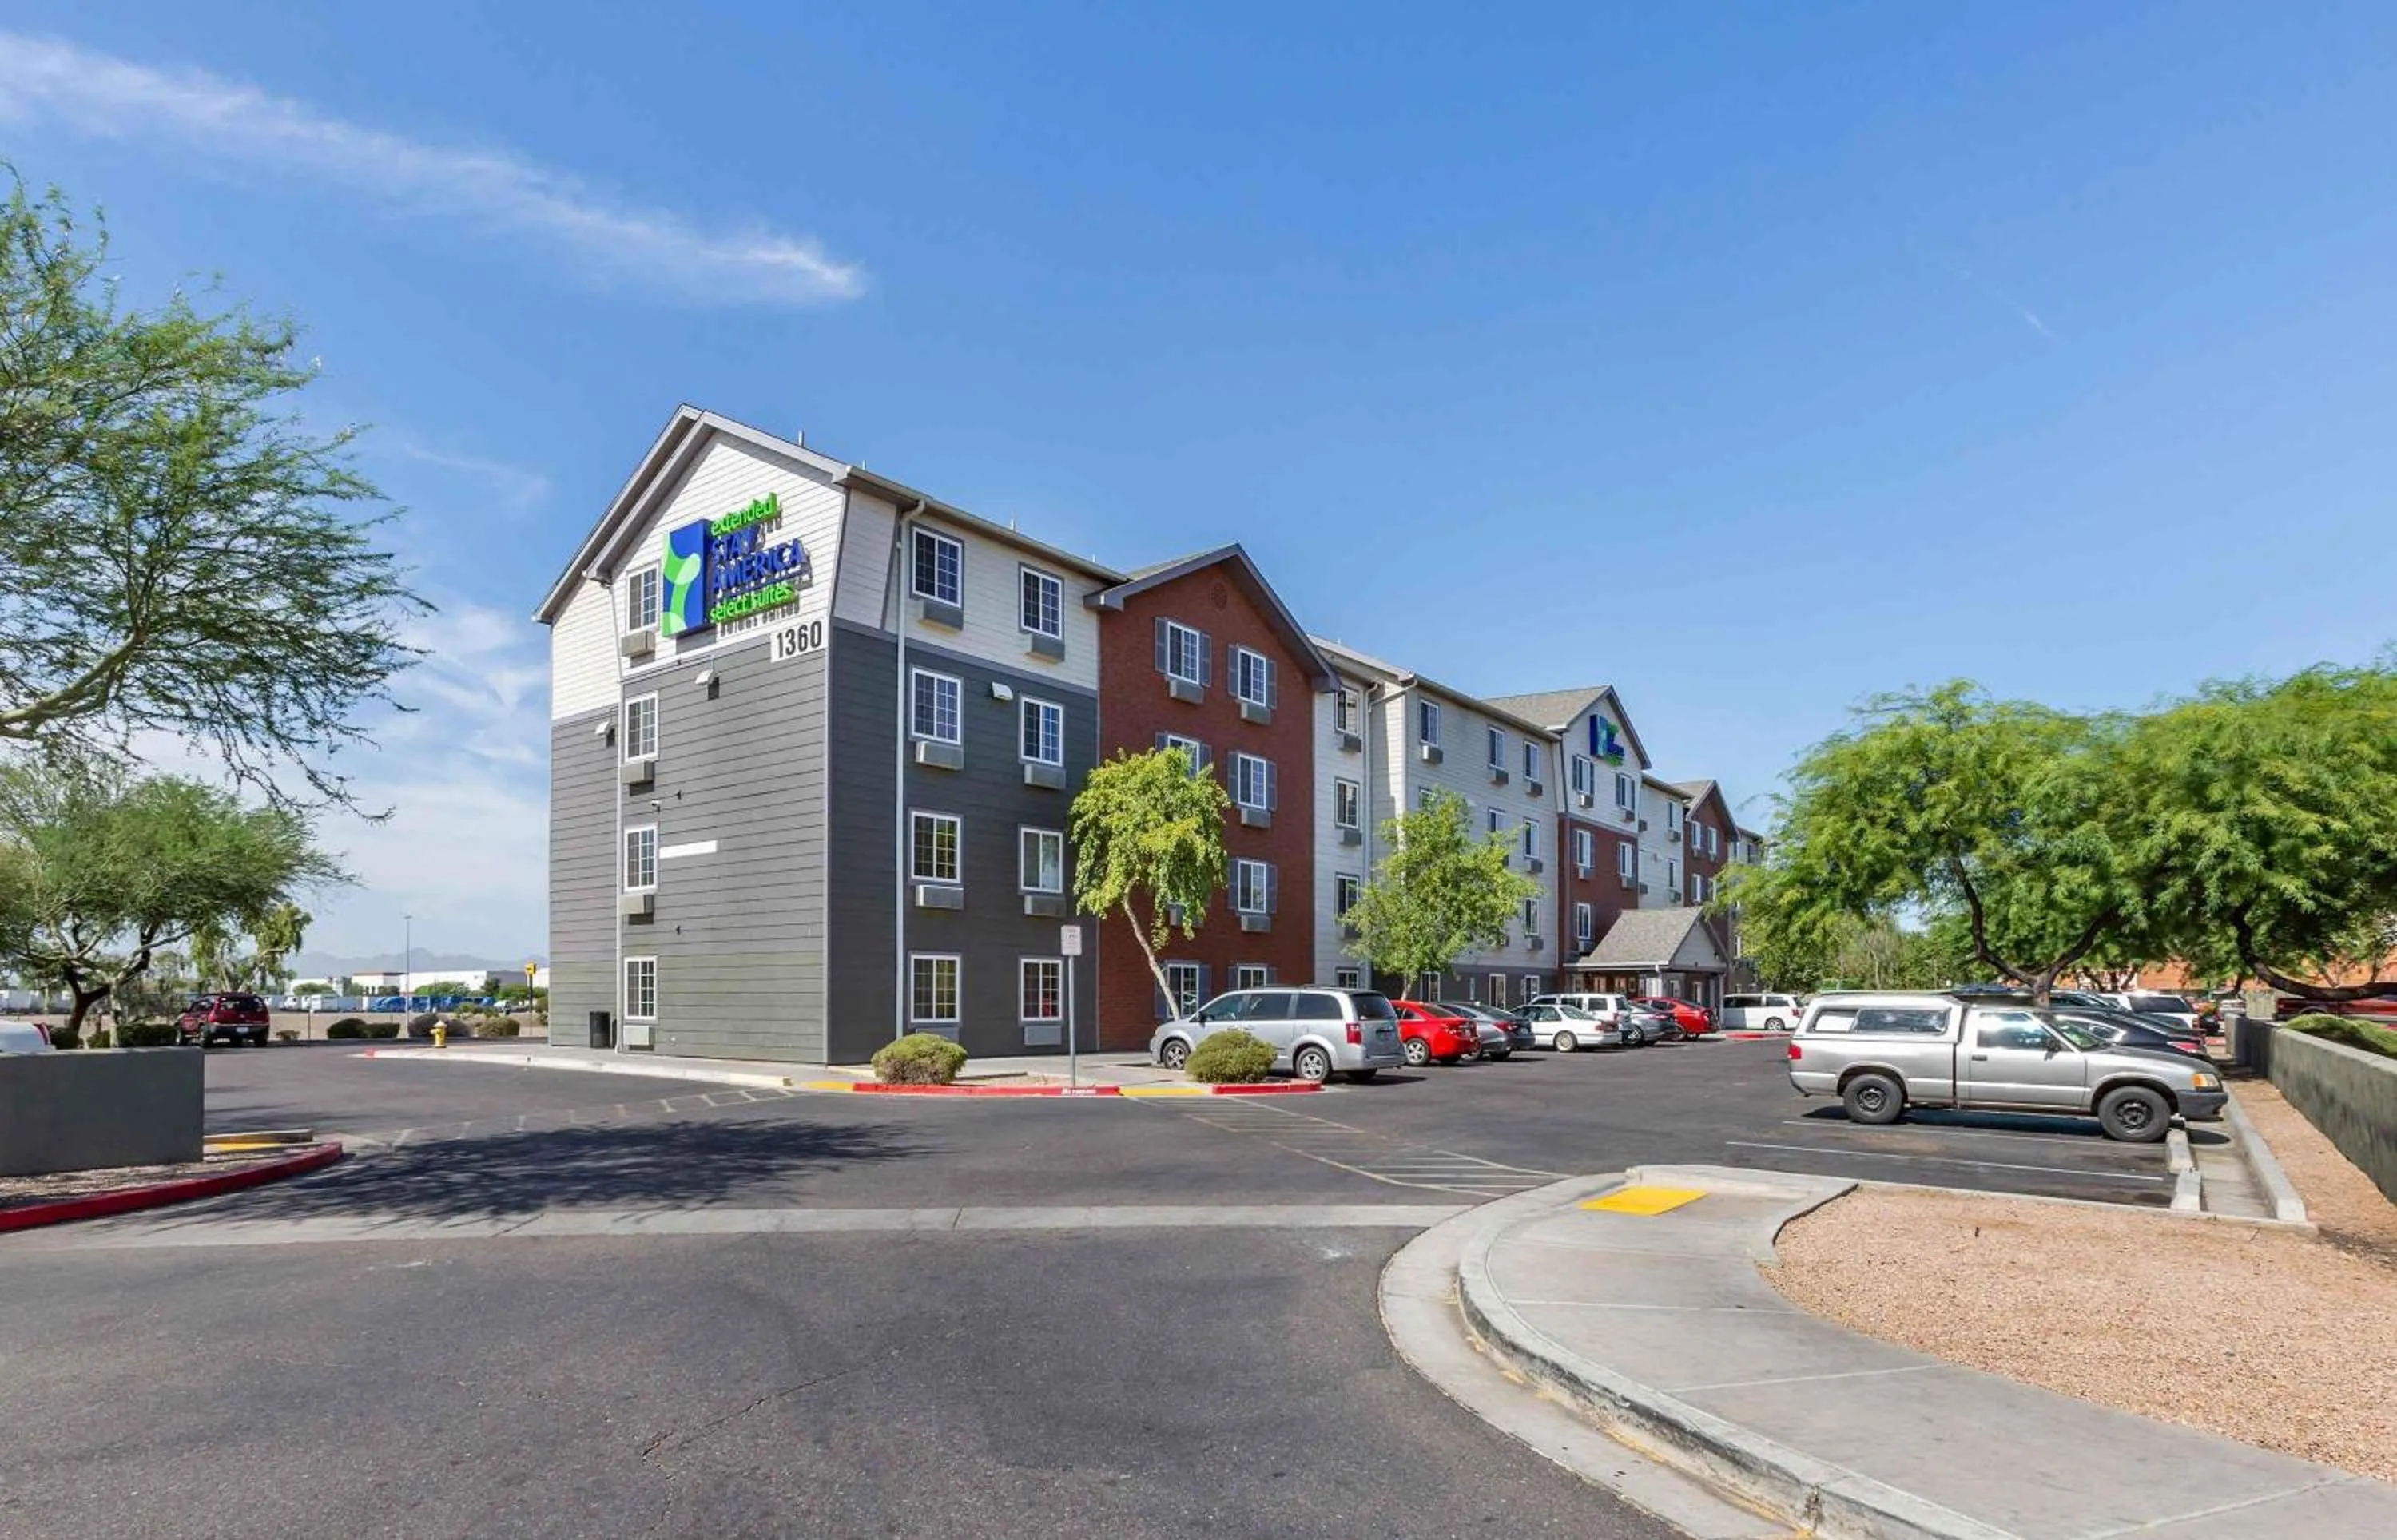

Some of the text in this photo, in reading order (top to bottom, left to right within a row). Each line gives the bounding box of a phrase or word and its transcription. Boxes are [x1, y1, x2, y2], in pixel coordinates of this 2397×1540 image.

[710, 492, 777, 537] extended
[712, 525, 758, 562] STAY
[713, 538, 805, 590] AMERICA
[710, 584, 793, 624] select suites
[777, 621, 822, 658] 1360
